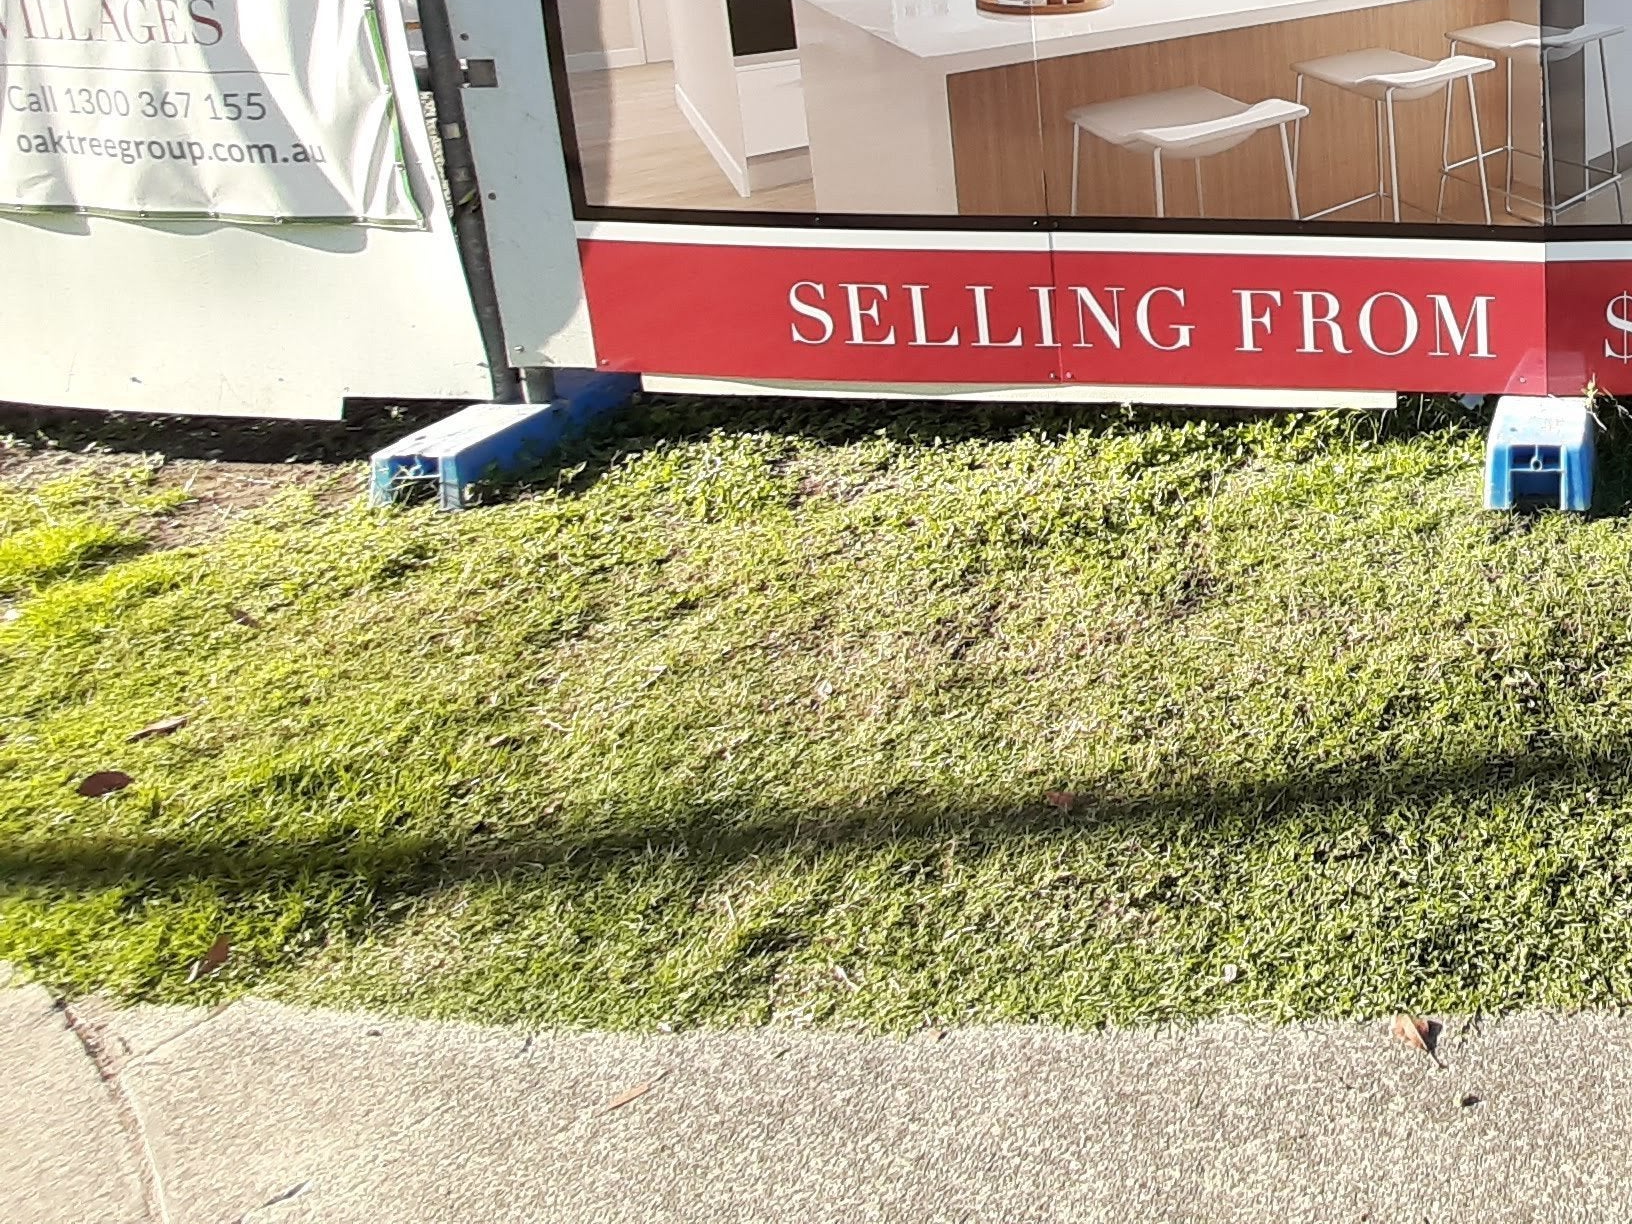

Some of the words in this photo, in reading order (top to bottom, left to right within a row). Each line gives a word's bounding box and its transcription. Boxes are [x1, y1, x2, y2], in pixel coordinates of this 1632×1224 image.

[8, 85, 58, 113] Call
[65, 87, 130, 117] 1300
[138, 90, 192, 119] 367
[204, 92, 267, 121] 155
[17, 126, 327, 165] oaktreegroup.com.au
[788, 281, 1197, 352] SELLING
[1231, 288, 1498, 359] FROM
